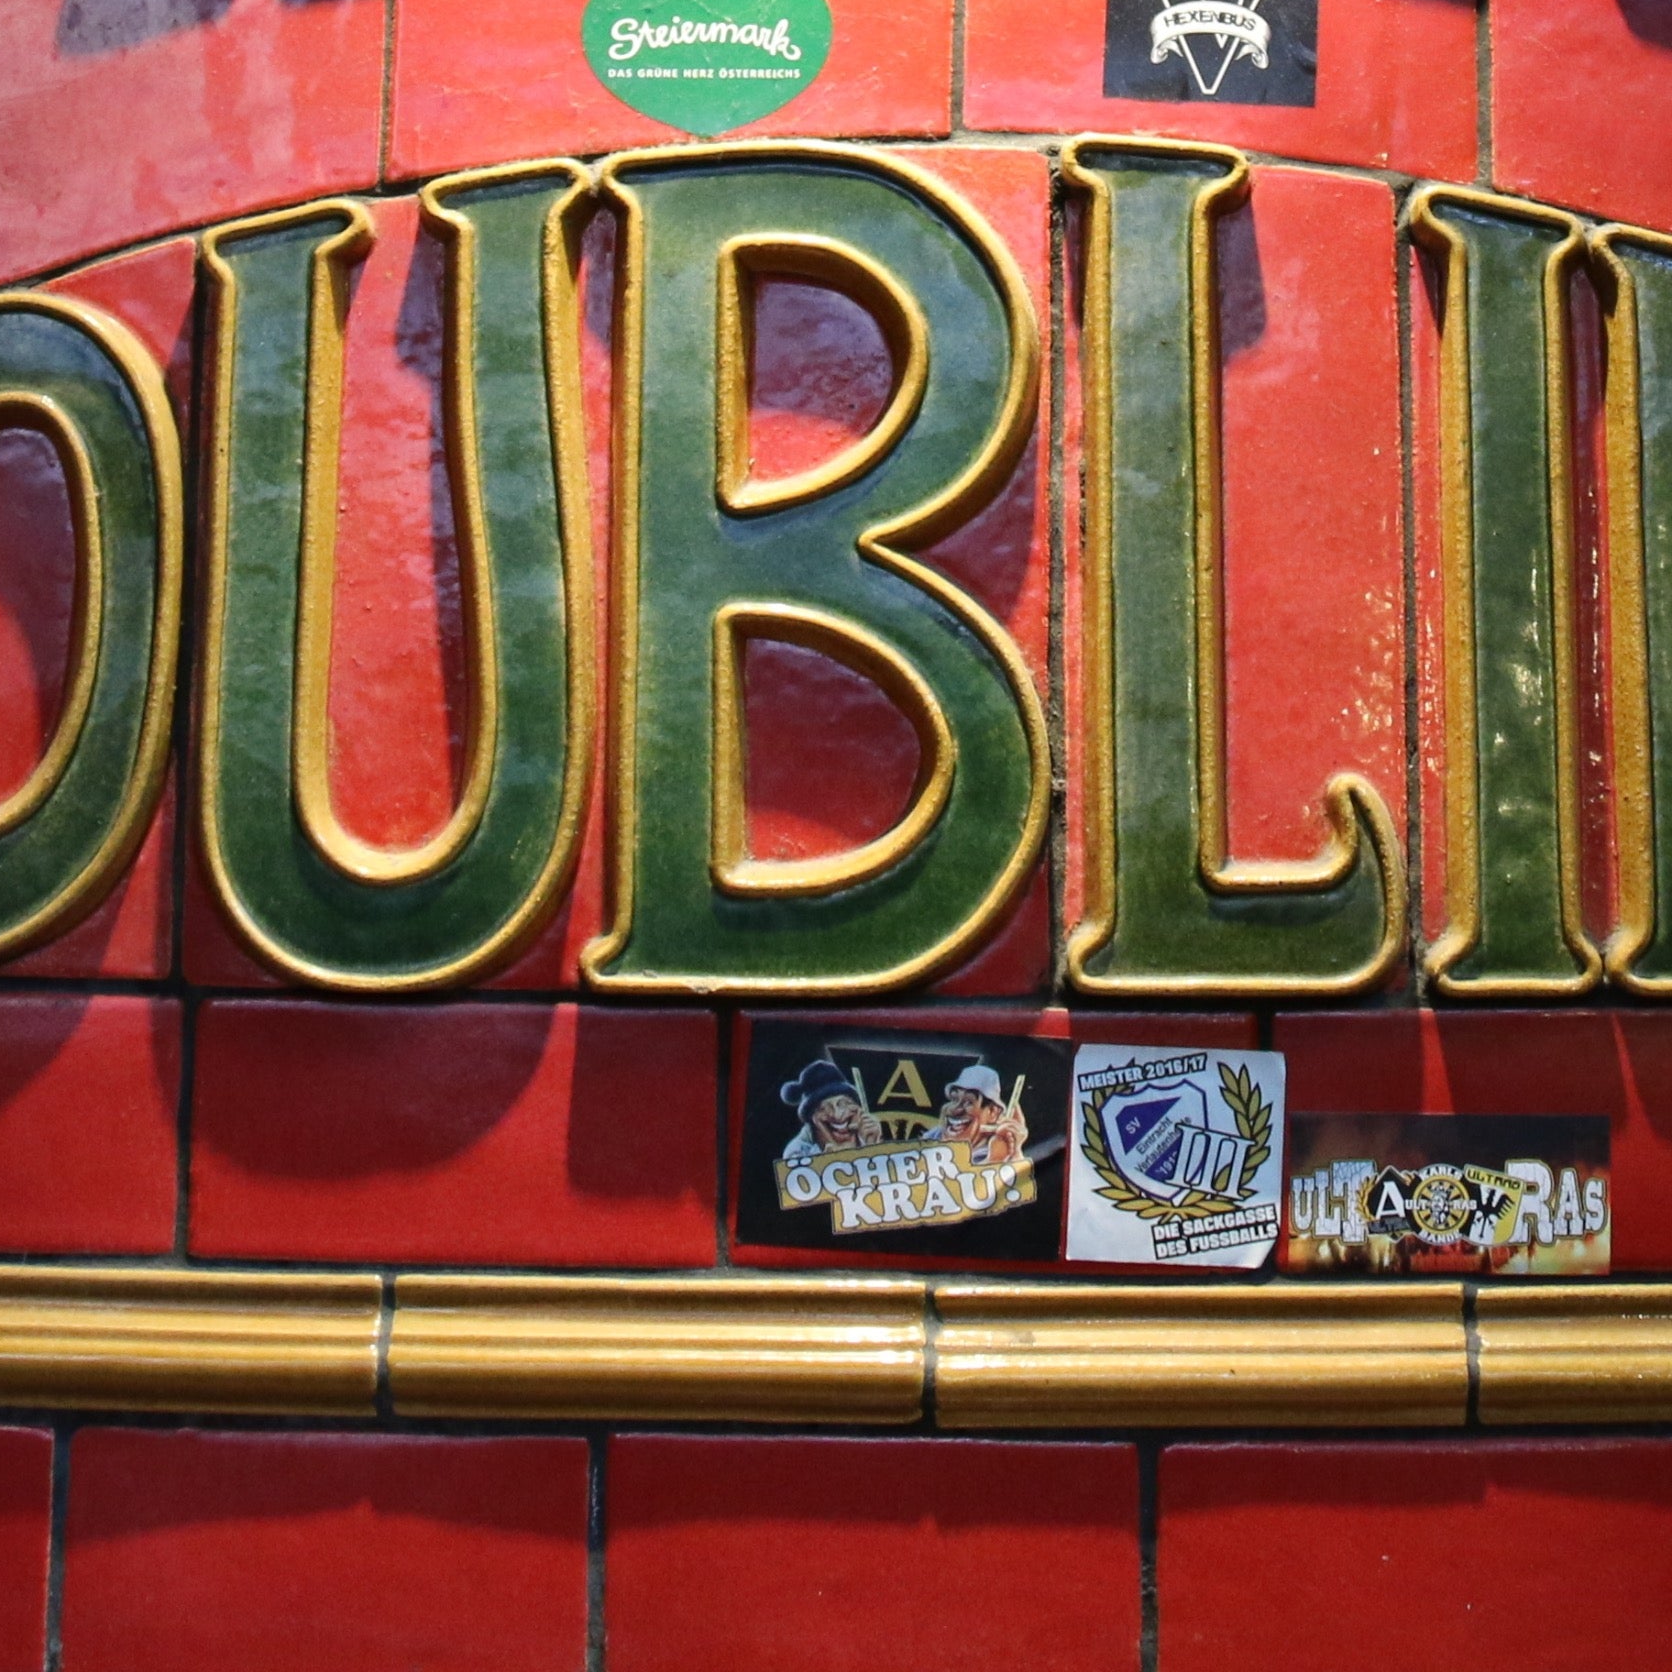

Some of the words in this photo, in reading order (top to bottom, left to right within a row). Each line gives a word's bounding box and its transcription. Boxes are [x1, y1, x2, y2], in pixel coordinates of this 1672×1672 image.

[608, 16, 802, 61] Steiermark
[1164, 10, 1257, 32] HEXENBUS
[608, 69, 632, 78] DAS
[637, 67, 678, 78] GRÜNE
[683, 69, 714, 78] HERZ
[719, 67, 801, 79] ÖSTERREICHS
[877, 1059, 932, 1108] A
[1079, 1067, 1143, 1091] MEISTER
[1145, 1054, 1206, 1078] 2016/17
[1125, 1116, 1141, 1135] SV
[1135, 1116, 1174, 1156] Eintracht
[785, 1145, 959, 1203] ÖCHER
[835, 1164, 1022, 1229] KRAU!
[1152, 1222, 1181, 1242] DIE
[1181, 1204, 1278, 1237] SACKGASSE
[1156, 1238, 1188, 1259] DES
[1188, 1221, 1279, 1254] FUSSBALLS
